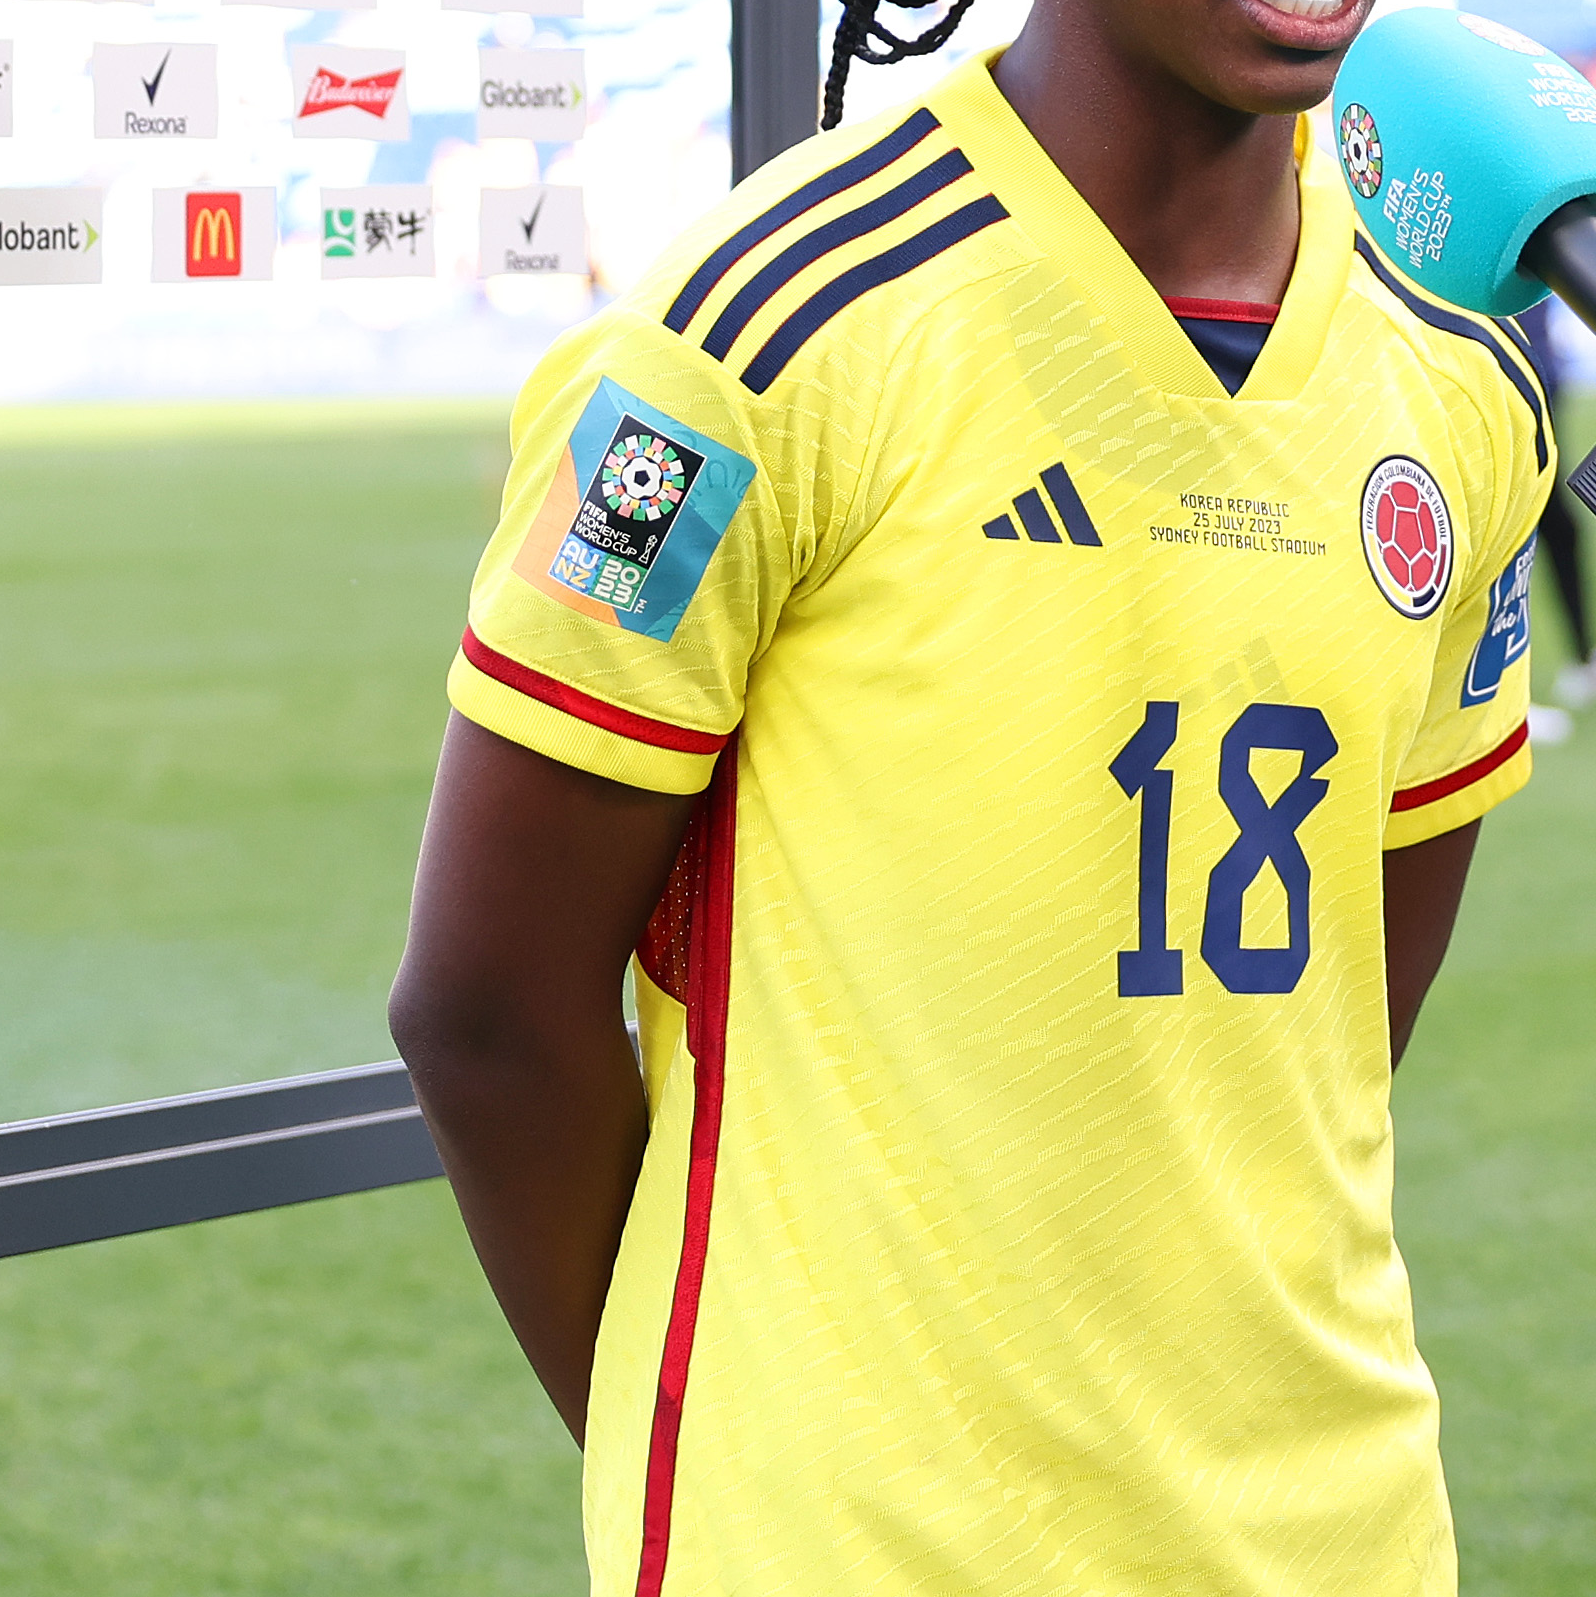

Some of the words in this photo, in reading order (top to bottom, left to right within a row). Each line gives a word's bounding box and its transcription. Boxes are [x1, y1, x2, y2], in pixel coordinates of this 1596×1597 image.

[482, 80, 566, 109] Globant
[124, 112, 187, 135] Rexona
[1383, 178, 1407, 224] FIFA
[1396, 168, 1429, 251] WOMEN'S
[1409, 211, 1431, 269] WORLD
[1423, 171, 1445, 211] CUP
[583, 500, 608, 524] FIFA
[1180, 493, 1223, 511] KOREA
[1228, 498, 1290, 518] REPUBLIC
[580, 512, 631, 544] WOMEN'S
[1193, 512, 1209, 528] 25
[1214, 515, 1245, 532] JULY
[1249, 518, 1281, 535] 2023
[575, 521, 613, 548] WORLD
[613, 542, 637, 556] CUP
[1150, 526, 1199, 545] SYDNEY
[1204, 531, 1267, 552] FOOTBALL
[1271, 538, 1326, 555] STADIUM
[562, 540, 600, 569] AU
[555, 557, 591, 589] NZ
[602, 559, 640, 584] 20
[594, 578, 633, 604] 23
[1107, 701, 1339, 997] 18
